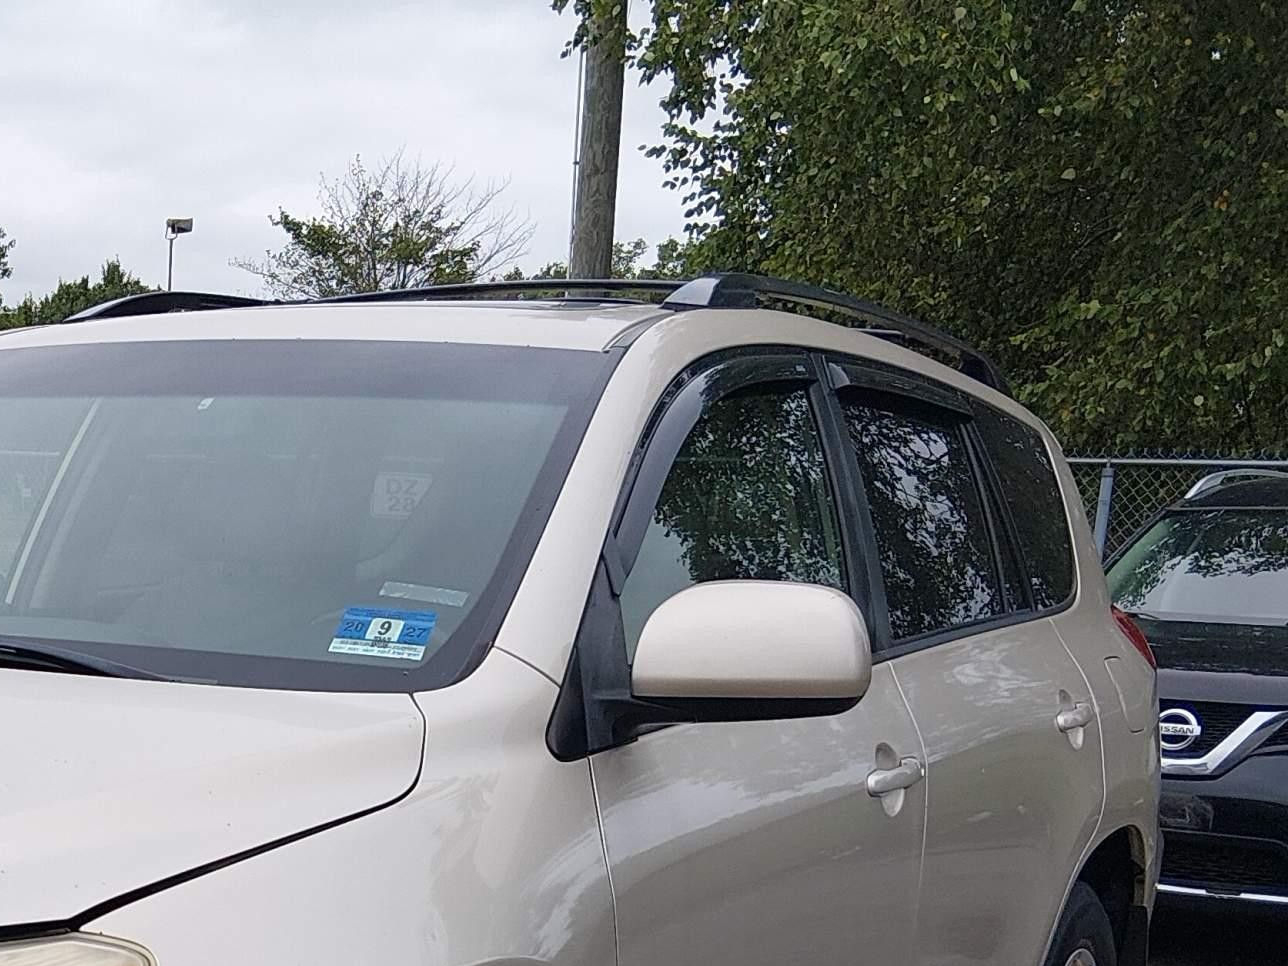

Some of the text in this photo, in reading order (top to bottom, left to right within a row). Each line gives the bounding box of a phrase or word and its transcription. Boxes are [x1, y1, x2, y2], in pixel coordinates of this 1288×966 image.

[385, 479, 418, 495] DZ
[388, 495, 416, 512] 28
[343, 620, 427, 639] 20 9 27
[1159, 725, 1195, 735] ISSAN
